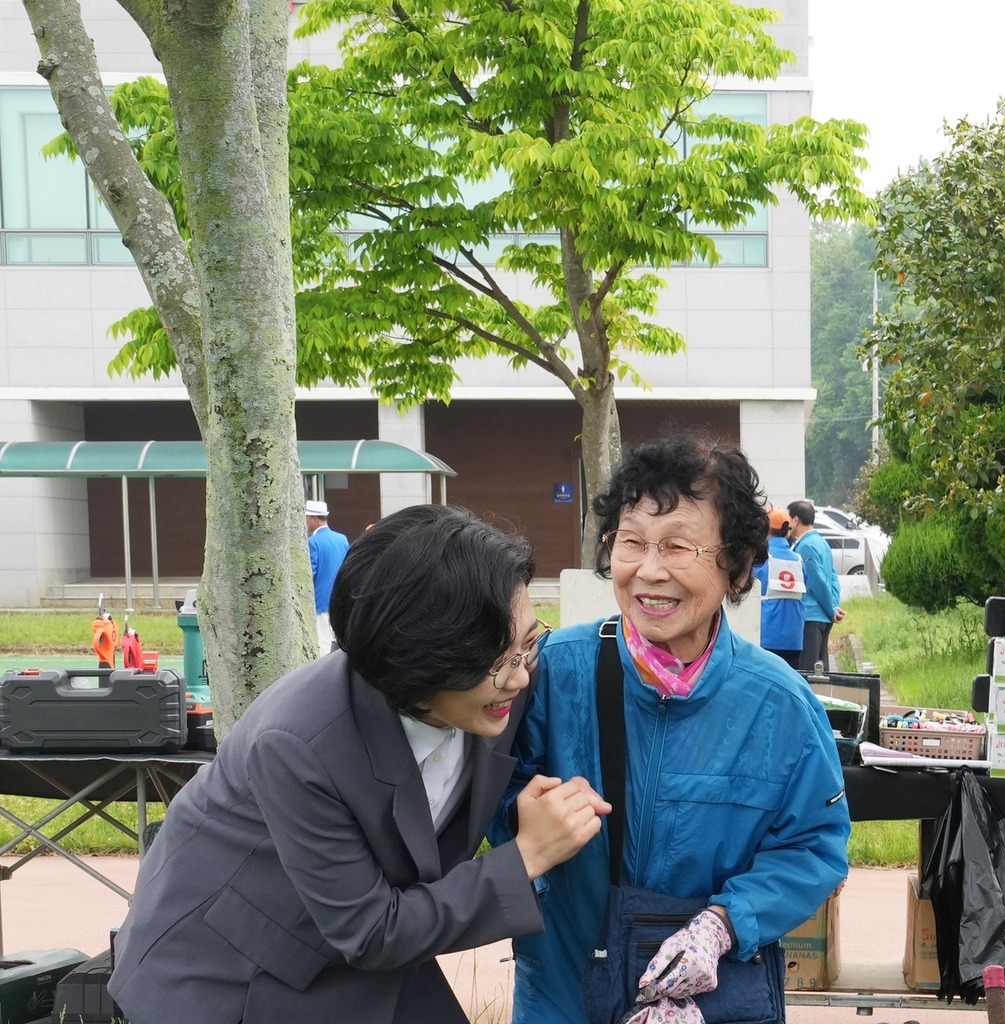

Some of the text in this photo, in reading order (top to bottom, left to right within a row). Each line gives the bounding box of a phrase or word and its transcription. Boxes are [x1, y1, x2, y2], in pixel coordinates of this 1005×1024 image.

[779, 571, 795, 590] 9
[782, 941, 812, 949] emium
[785, 951, 819, 960] NANAS
[797, 977, 804, 987] 8
[809, 978, 817, 988] 9
